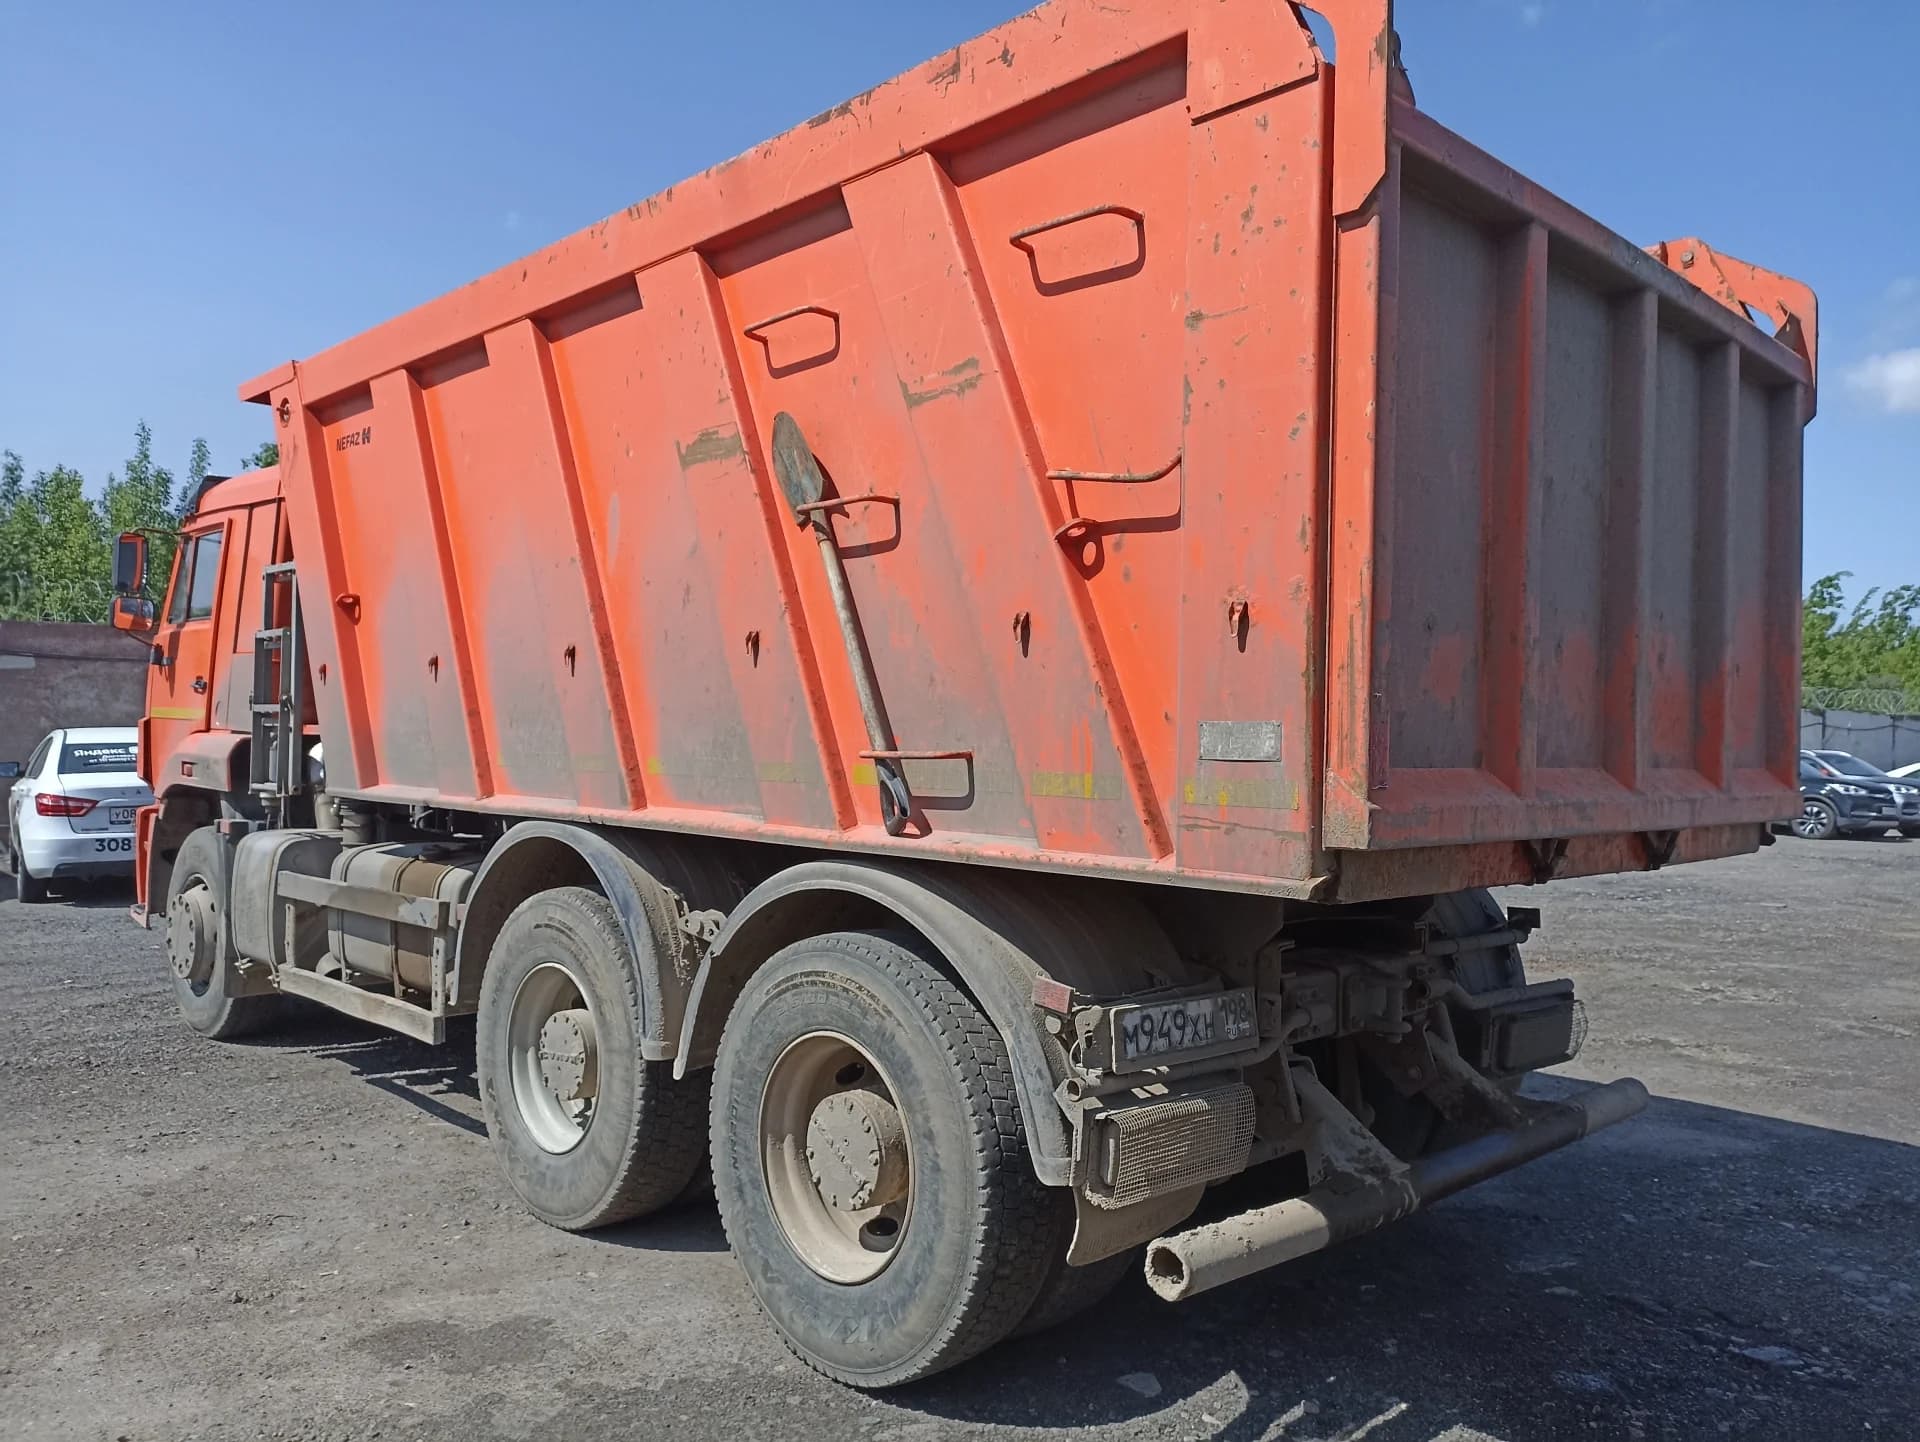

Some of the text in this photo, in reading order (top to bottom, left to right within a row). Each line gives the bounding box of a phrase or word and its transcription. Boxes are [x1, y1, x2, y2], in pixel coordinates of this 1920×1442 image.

[336, 431, 361, 452] NEFAZ
[95, 838, 132, 852] 308
[1122, 1009, 1217, 1056] М949ХН
